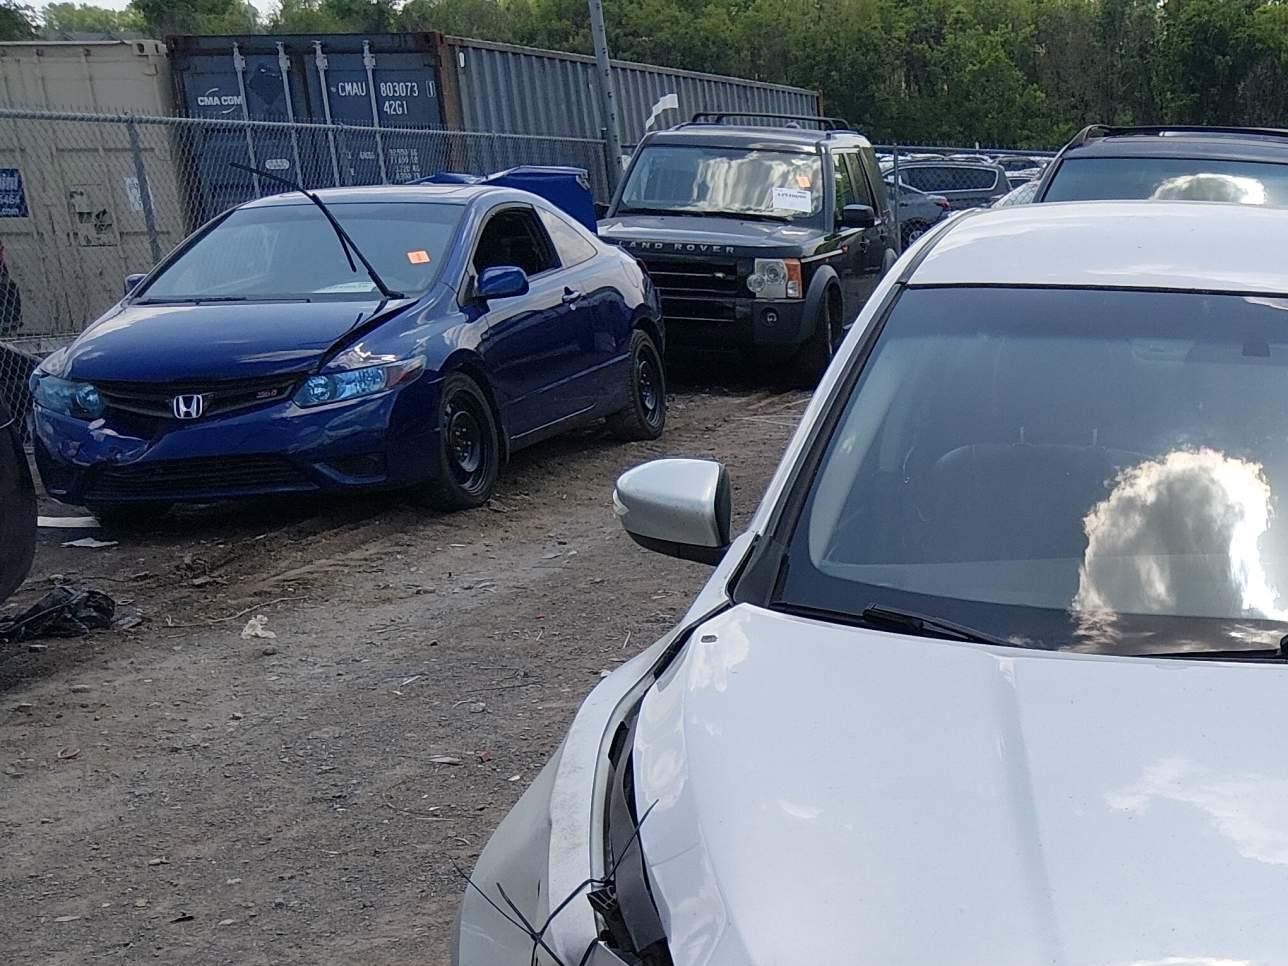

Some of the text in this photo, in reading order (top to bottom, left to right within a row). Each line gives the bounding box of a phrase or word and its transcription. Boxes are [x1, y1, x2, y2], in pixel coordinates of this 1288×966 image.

[338, 82, 366, 96] CMAU
[380, 82, 419, 97] 803073
[197, 96, 220, 106] CMA
[383, 100, 408, 115] 42G1
[674, 243, 735, 254] ROVER
